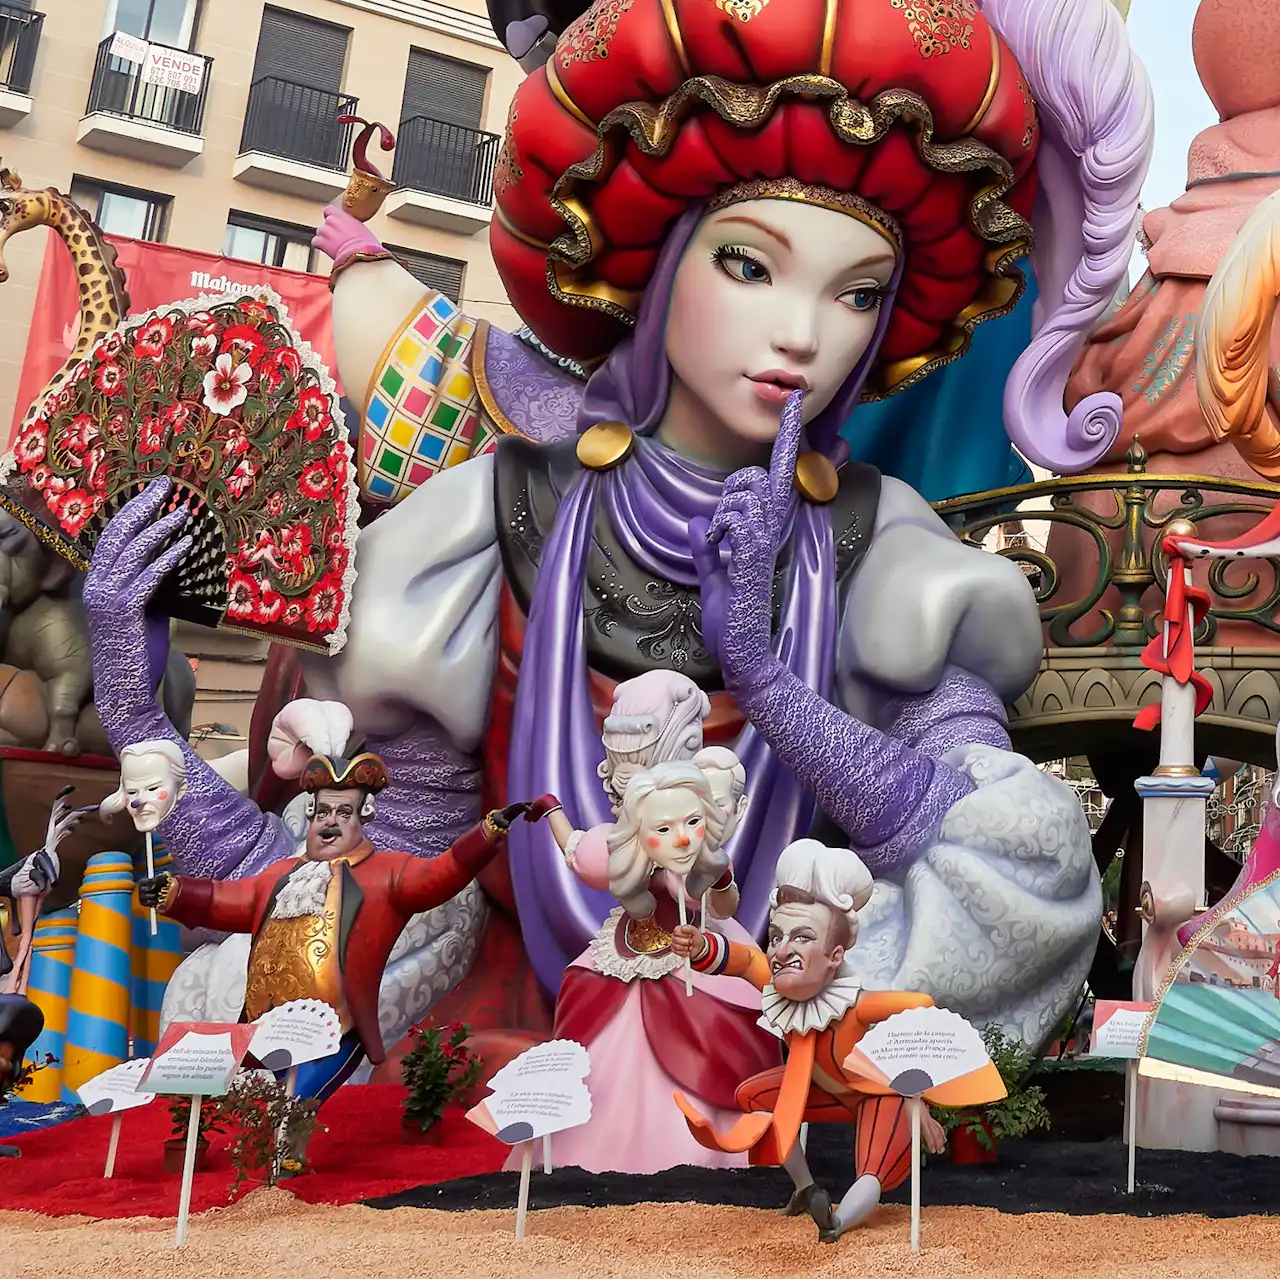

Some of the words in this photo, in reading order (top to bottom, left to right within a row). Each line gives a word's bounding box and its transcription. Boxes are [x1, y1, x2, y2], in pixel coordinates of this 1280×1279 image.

[150, 66, 166, 76] 677
[152, 54, 201, 76] VENDE
[149, 74, 164, 84] 626
[167, 77, 181, 88] 706
[183, 82, 196, 93] 530
